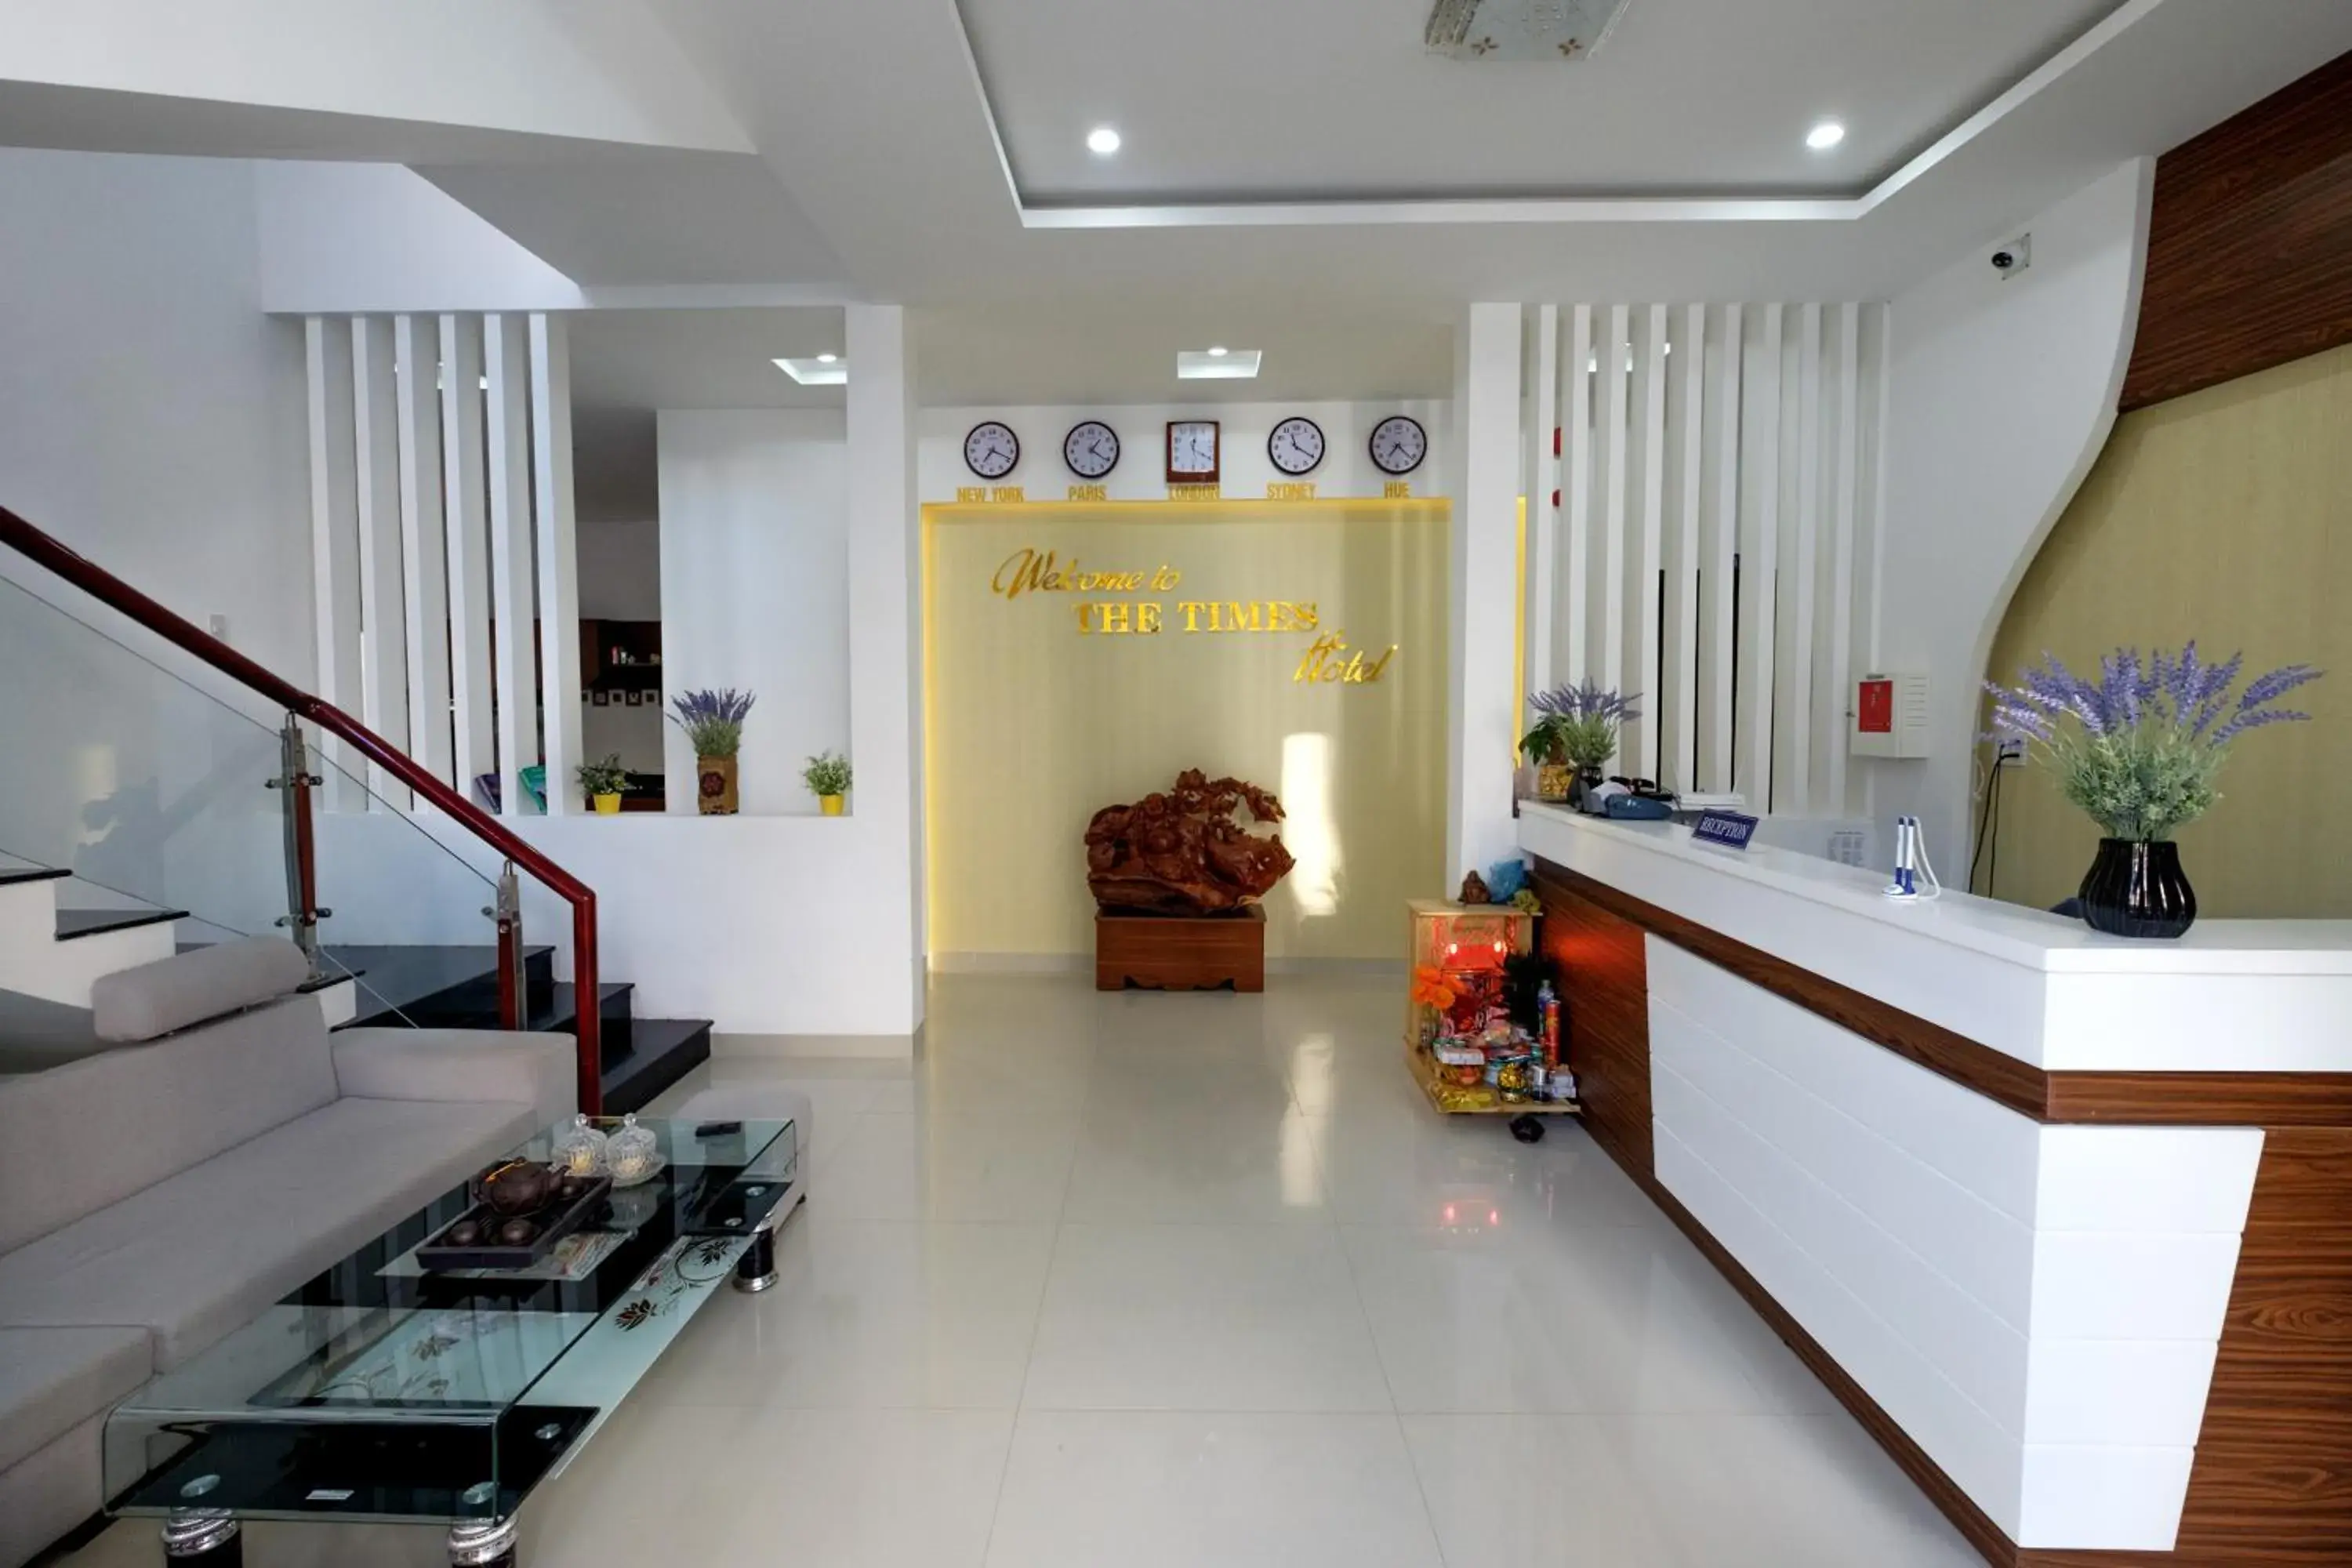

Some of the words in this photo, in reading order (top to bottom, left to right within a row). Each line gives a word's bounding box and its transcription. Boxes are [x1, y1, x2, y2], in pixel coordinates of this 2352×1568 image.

[957, 486, 985, 502] NEW
[992, 486, 1024, 502] YORK
[1069, 485, 1106, 501] PARIS
[1384, 482, 1410, 498] HUE
[992, 548, 1142, 600] Welcome
[1149, 564, 1181, 592] to
[1073, 601, 1163, 635] THE
[1178, 601, 1319, 633] TIMES
[1294, 628, 1399, 684] Hotel
[1700, 816, 1748, 840] RECEPTION
